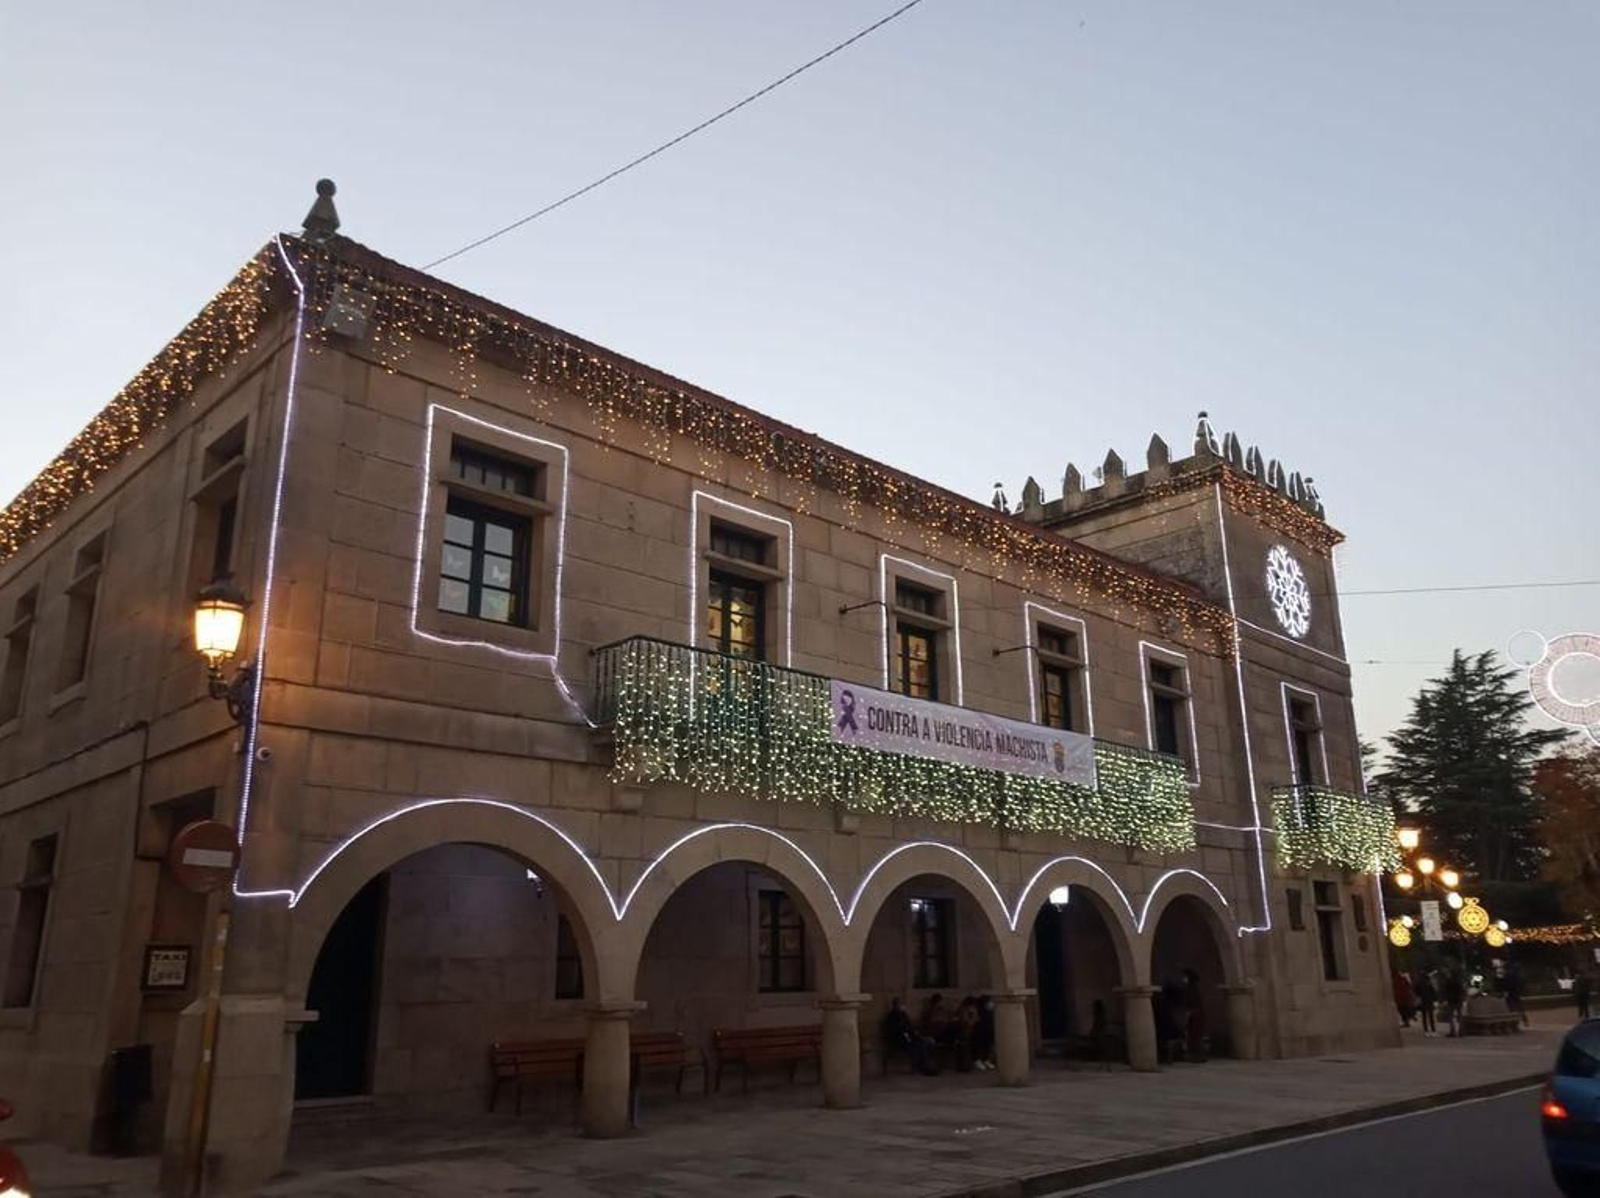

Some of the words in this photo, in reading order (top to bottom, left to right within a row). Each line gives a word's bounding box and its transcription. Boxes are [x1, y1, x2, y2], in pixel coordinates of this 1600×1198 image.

[867, 706, 919, 739] CONTRA
[922, 717, 931, 740] A
[933, 721, 993, 752] VIOLENCIA
[996, 732, 1049, 763] MACHISTA
[151, 953, 187, 961] TAXI
